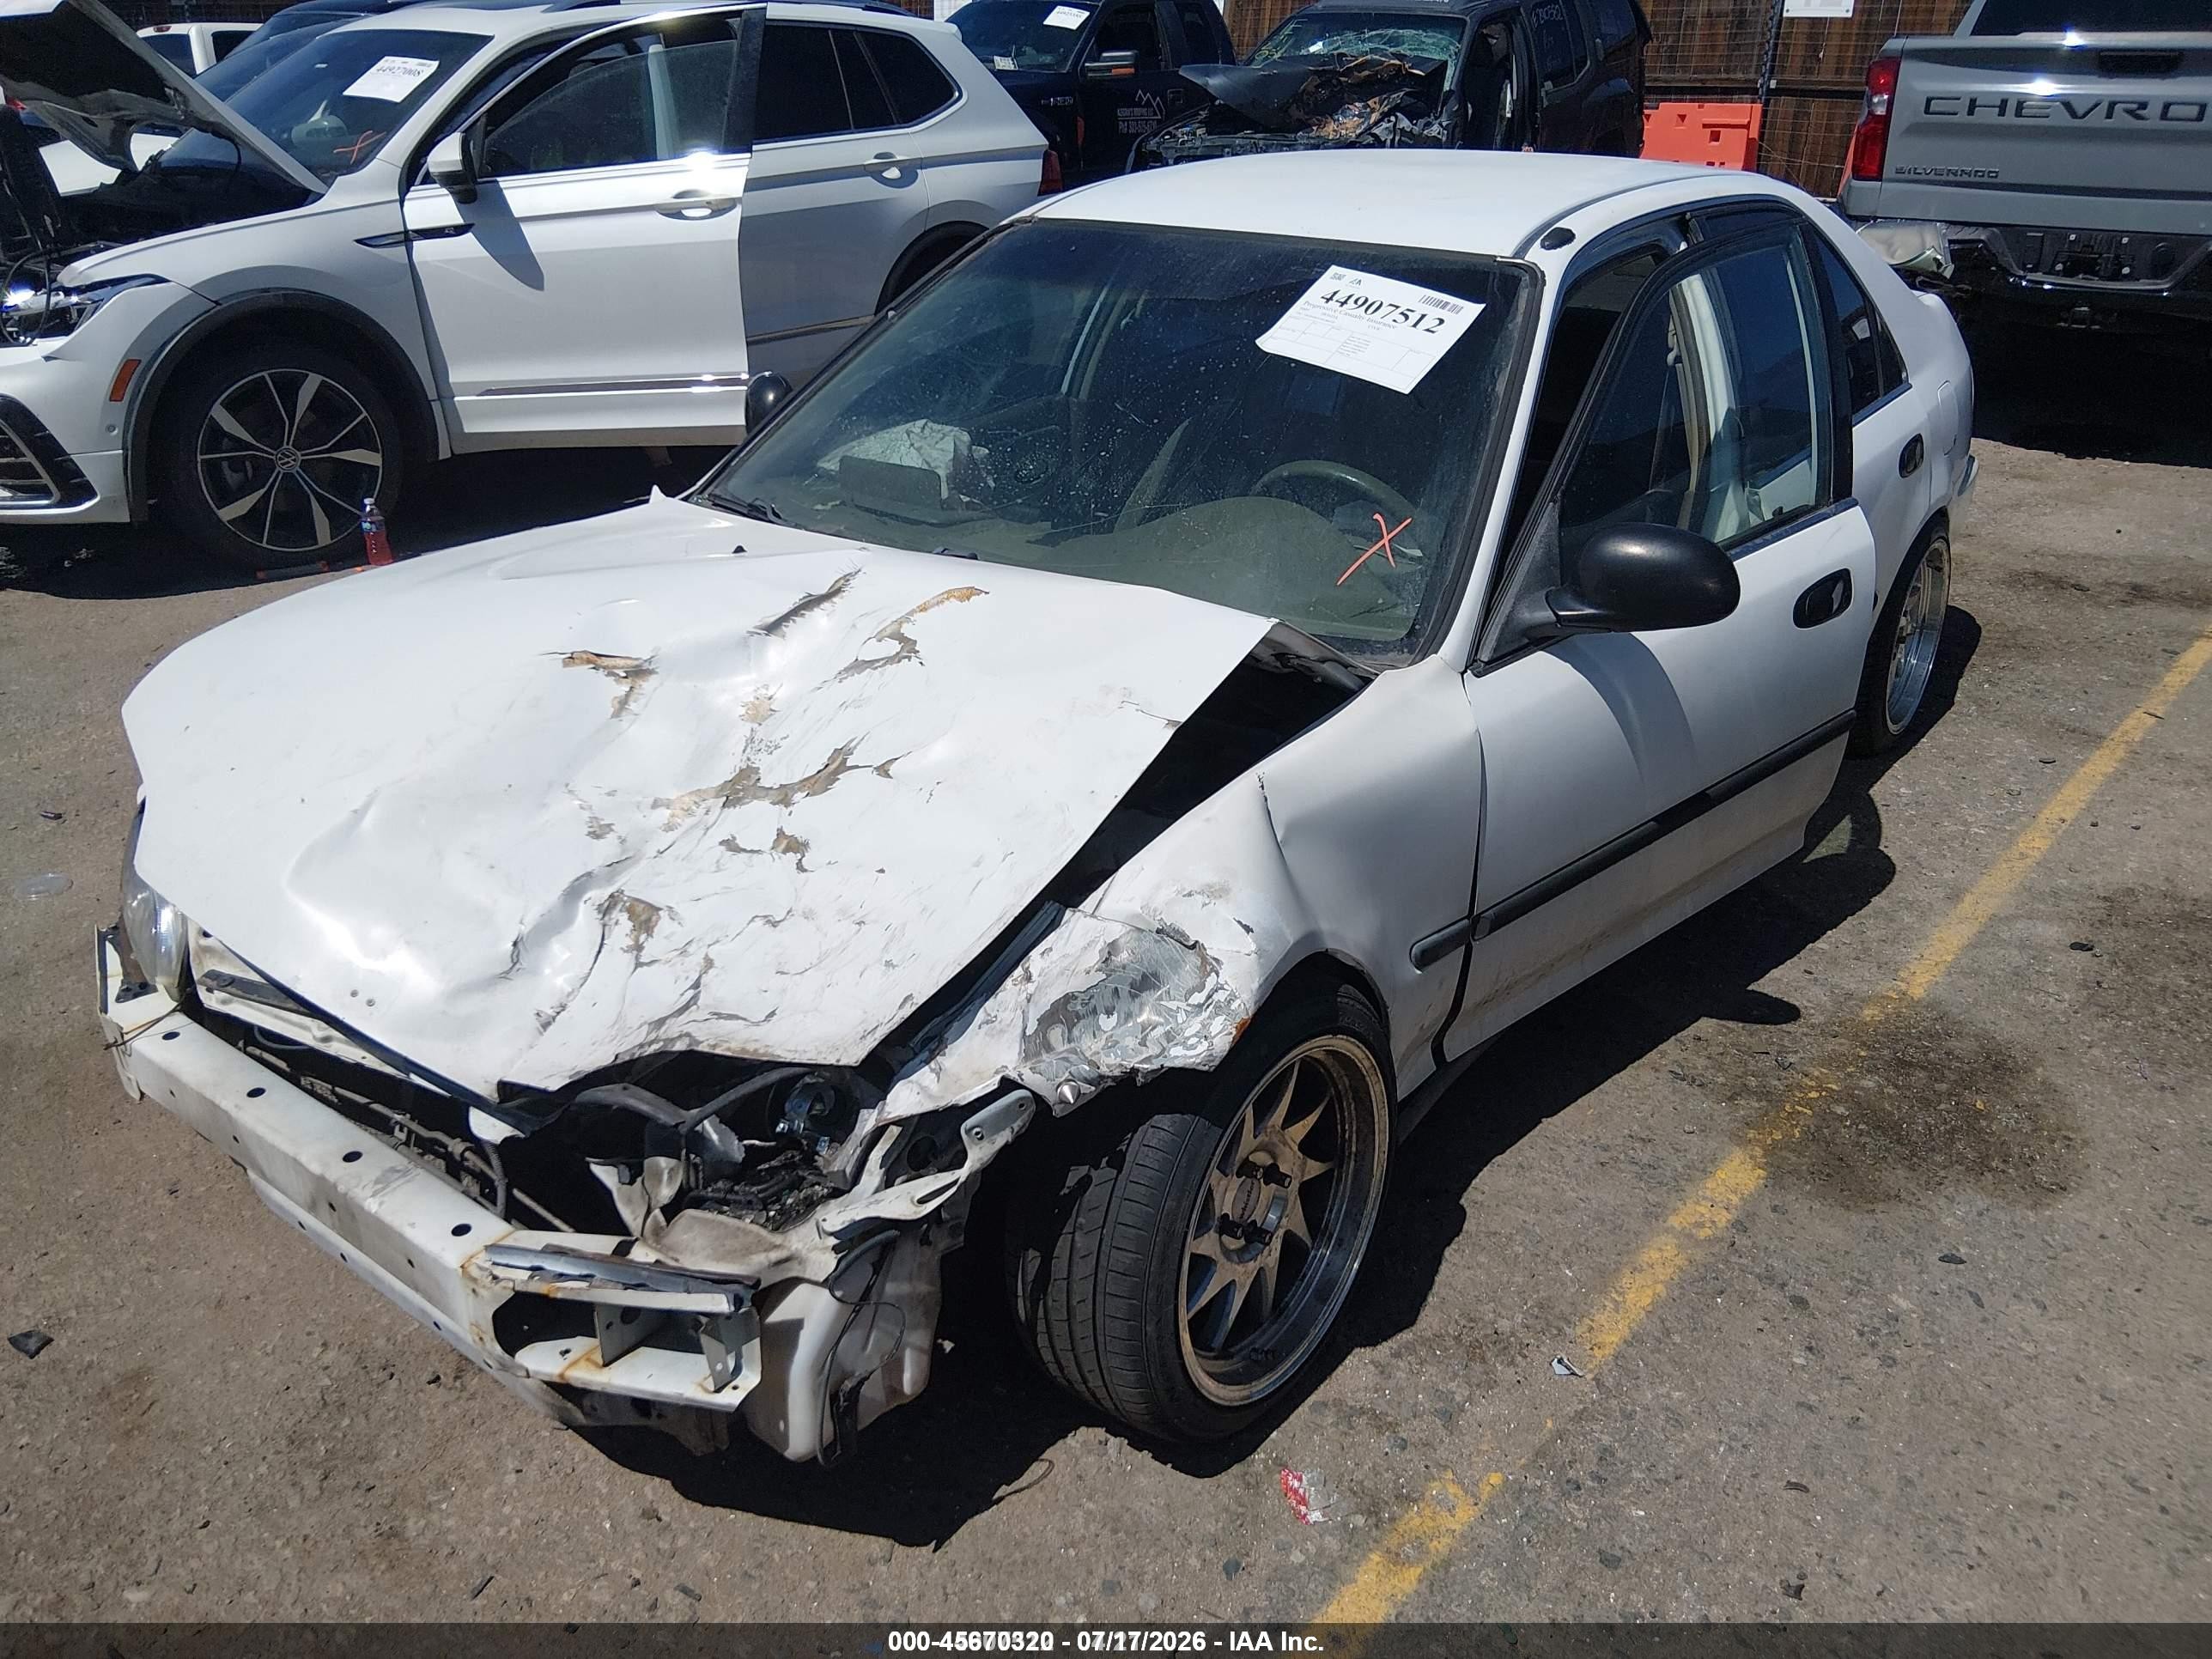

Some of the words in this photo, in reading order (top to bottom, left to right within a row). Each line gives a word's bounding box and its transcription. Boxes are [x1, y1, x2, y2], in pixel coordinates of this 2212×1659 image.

[1894, 165, 2000, 179] SILVERADO
[1304, 301, 1338, 313] Progressive
[1339, 309, 1364, 321] Casualty
[1366, 317, 1397, 330] Insurance
[1320, 289, 1446, 335] 44907512
